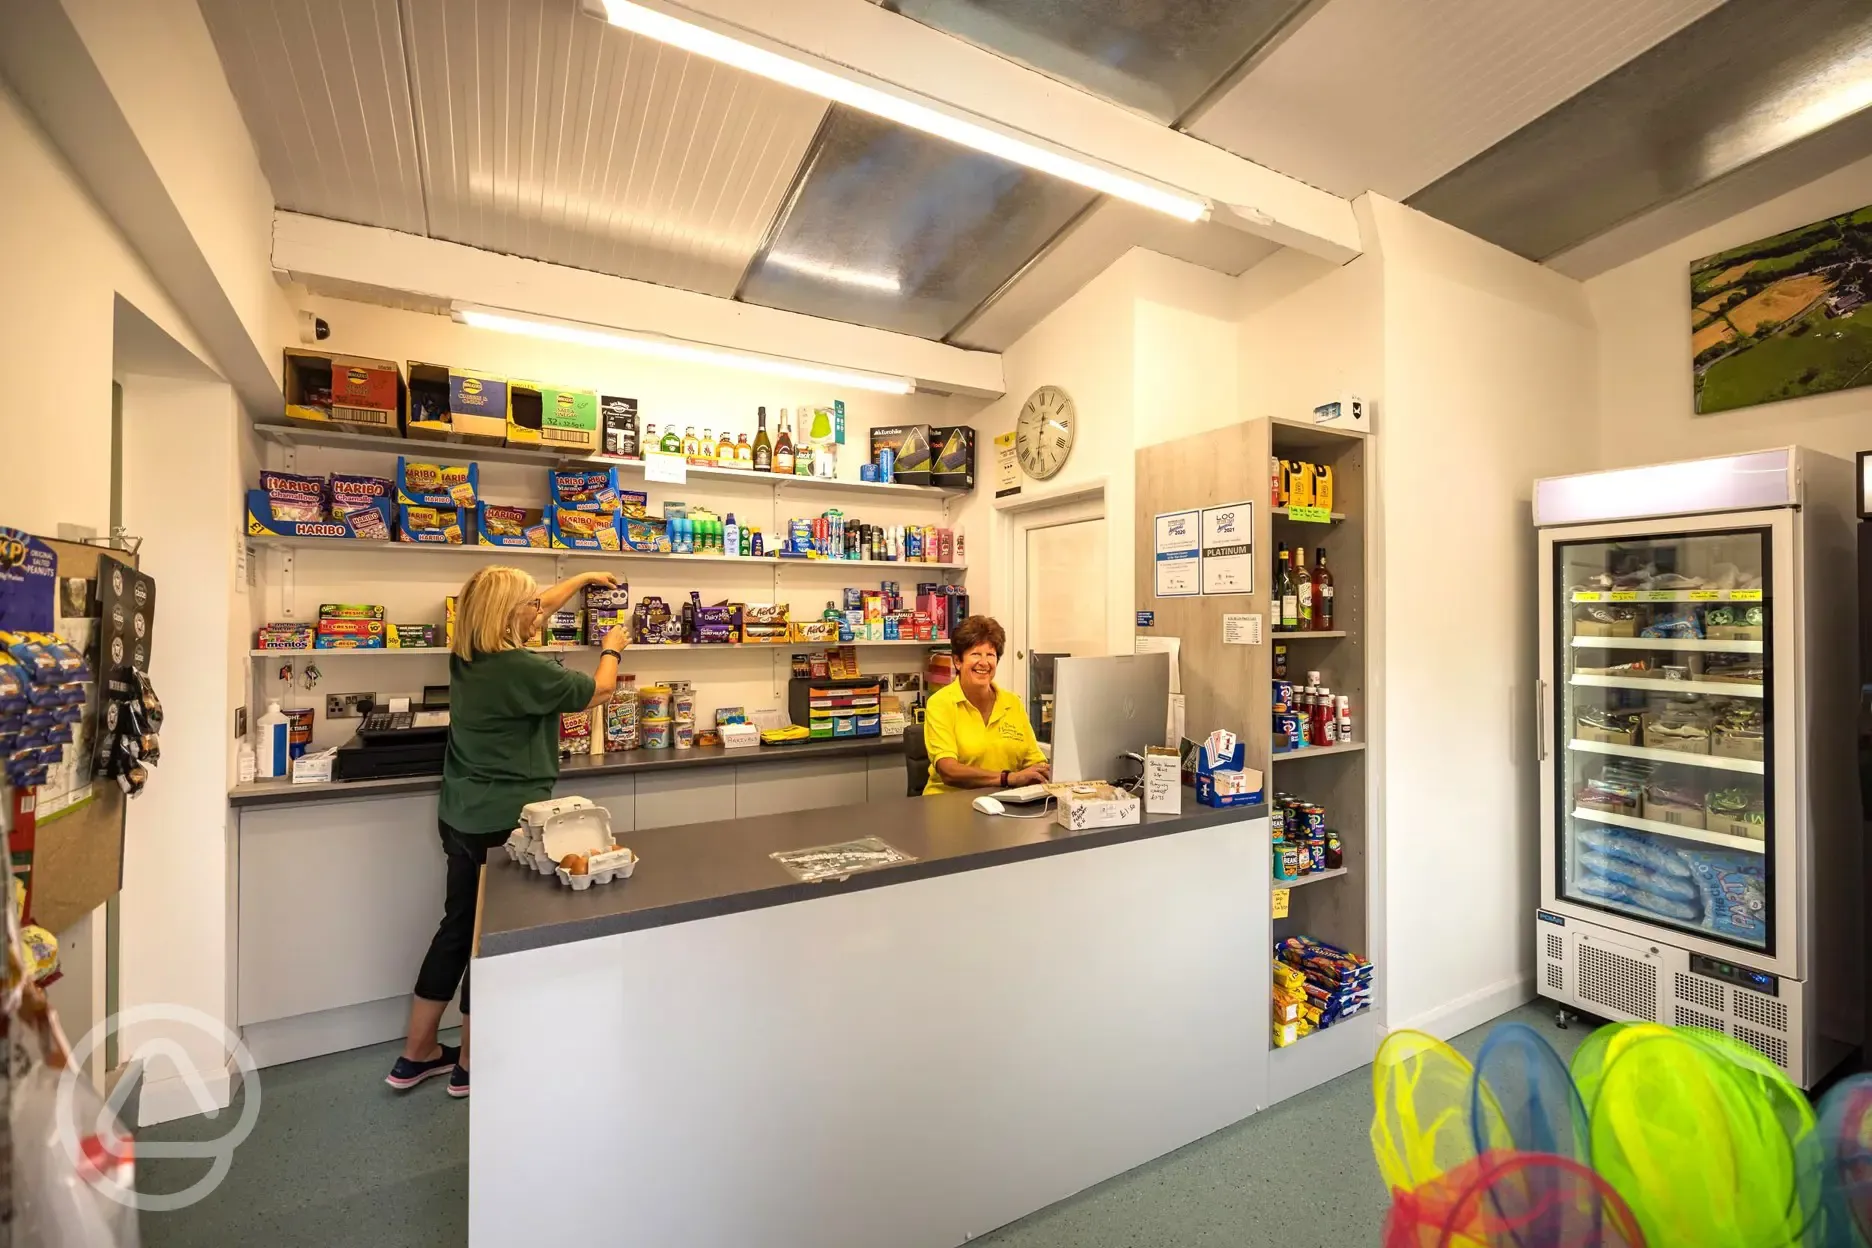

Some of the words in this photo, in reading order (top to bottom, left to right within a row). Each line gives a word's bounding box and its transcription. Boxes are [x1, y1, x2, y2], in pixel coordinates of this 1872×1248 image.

[267, 476, 321, 493] HARIBO
[333, 480, 384, 496] HARIBO
[486, 507, 524, 522] HARIBO
[560, 514, 592, 525] HARIBO
[296, 523, 346, 536] HARIBO
[418, 534, 446, 542] HARIBO
[1207, 545, 1247, 557] PLATINUM
[27, 564, 55, 577] PEANUTS
[266, 640, 308, 648] mentos
